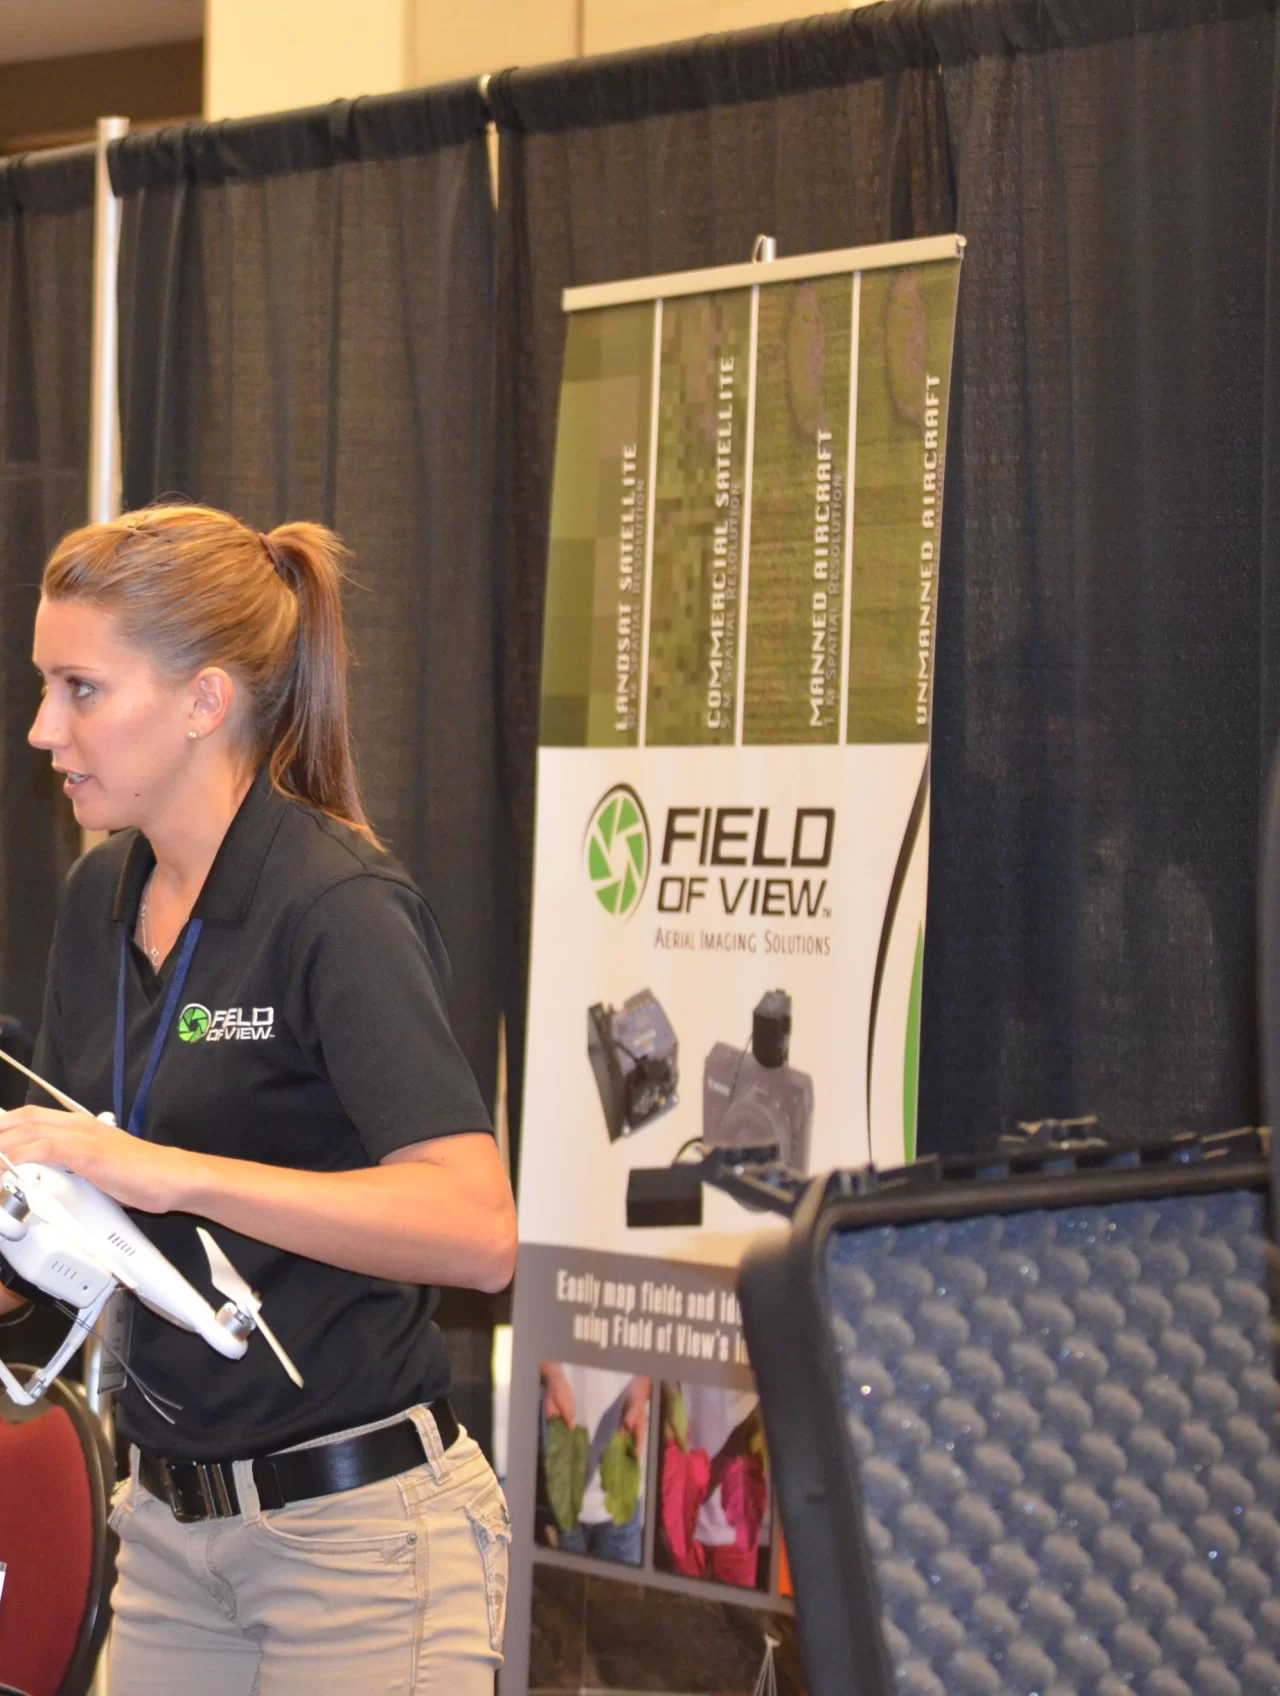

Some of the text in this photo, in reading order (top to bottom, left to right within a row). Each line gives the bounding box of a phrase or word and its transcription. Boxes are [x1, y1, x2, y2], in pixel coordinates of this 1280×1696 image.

[922, 374, 940, 528] AIRCRAFT
[616, 444, 636, 730] LANDSAT SATELLITE
[632, 480, 645, 593] RESOLUTION
[708, 356, 735, 729] COMMERCIAL SATELLITE
[726, 484, 740, 600] RESOLUTION
[810, 429, 832, 726] MANNED AIRCRAFT
[829, 475, 842, 595] RESOLUTION
[722, 608, 735, 681] SPATIAL
[825, 608, 838, 680] SPATIAL
[916, 541, 934, 725] UNMANNED
[661, 807, 836, 868] FIELD
[657, 876, 708, 913] OF
[719, 877, 827, 918] VIEW
[224, 1026, 273, 1041] VIEW
[557, 1268, 601, 1310] Easily
[604, 1280, 636, 1314] map
[641, 1280, 683, 1317] fields
[687, 1289, 715, 1322] and
[574, 1312, 609, 1349] using
[613, 1314, 653, 1351] Field
[657, 1322, 673, 1354] of
[677, 1323, 729, 1363] View's
